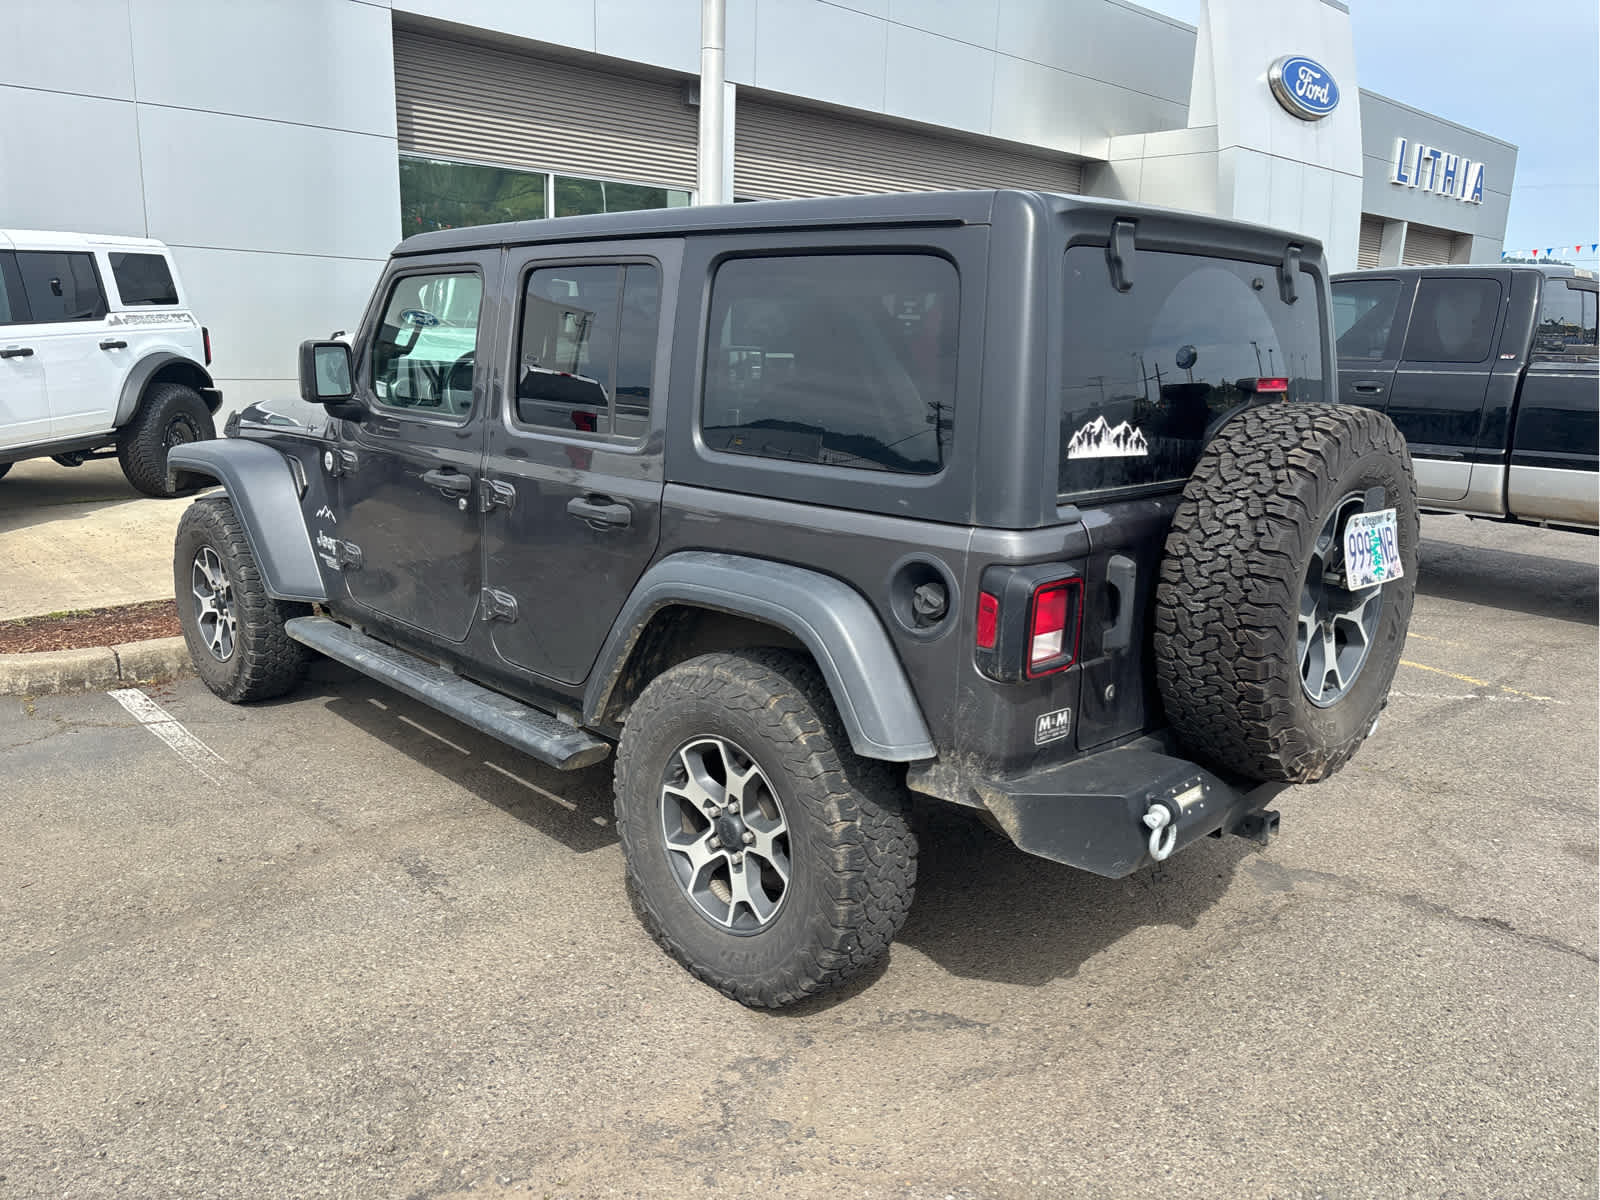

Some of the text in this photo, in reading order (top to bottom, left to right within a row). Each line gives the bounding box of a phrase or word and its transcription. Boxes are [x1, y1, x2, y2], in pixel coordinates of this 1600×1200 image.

[1295, 66, 1330, 105] Ford
[1392, 137, 1485, 205] LITHIA
[1348, 530, 1372, 571] 999
